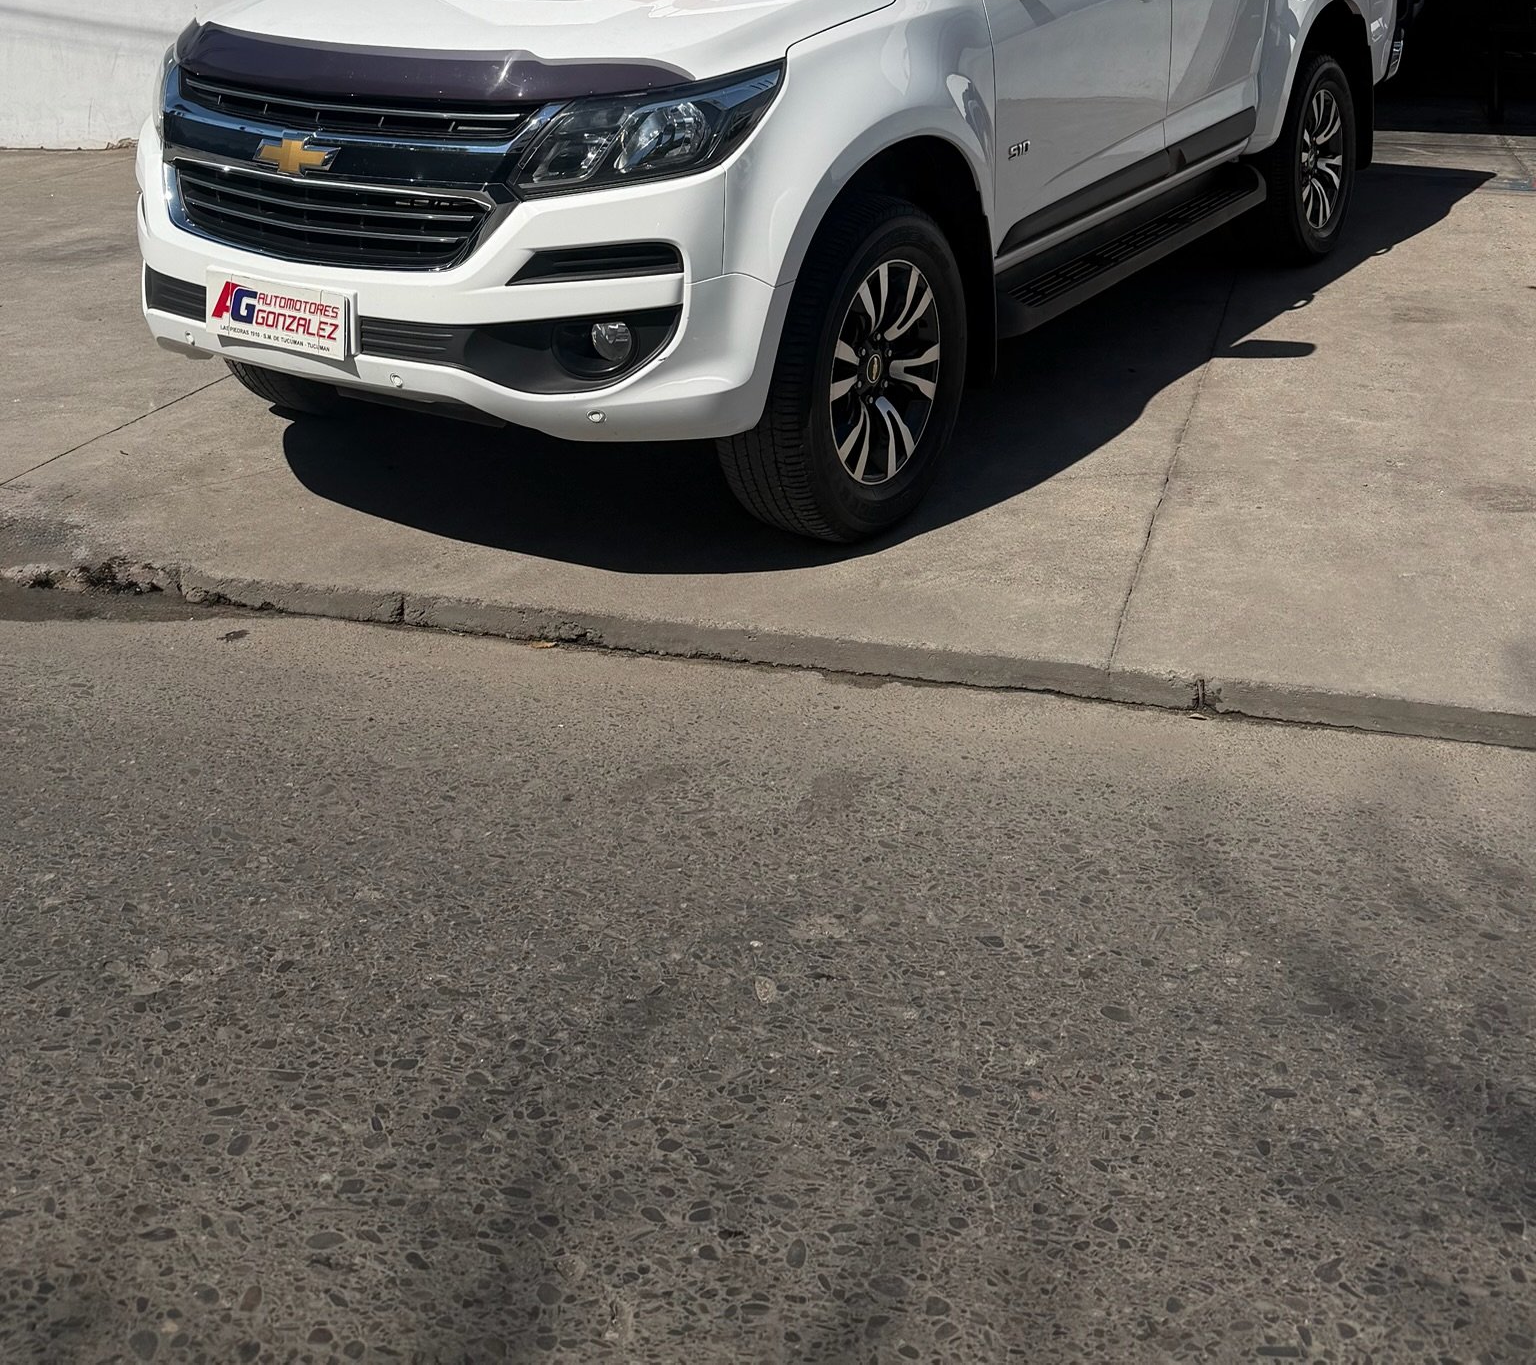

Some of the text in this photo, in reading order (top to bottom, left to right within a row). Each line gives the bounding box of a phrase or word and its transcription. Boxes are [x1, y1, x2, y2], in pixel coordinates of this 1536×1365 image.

[211, 281, 259, 325] AG
[258, 292, 340, 319] AUTOMOTORES
[255, 309, 339, 341] GONZALEZ
